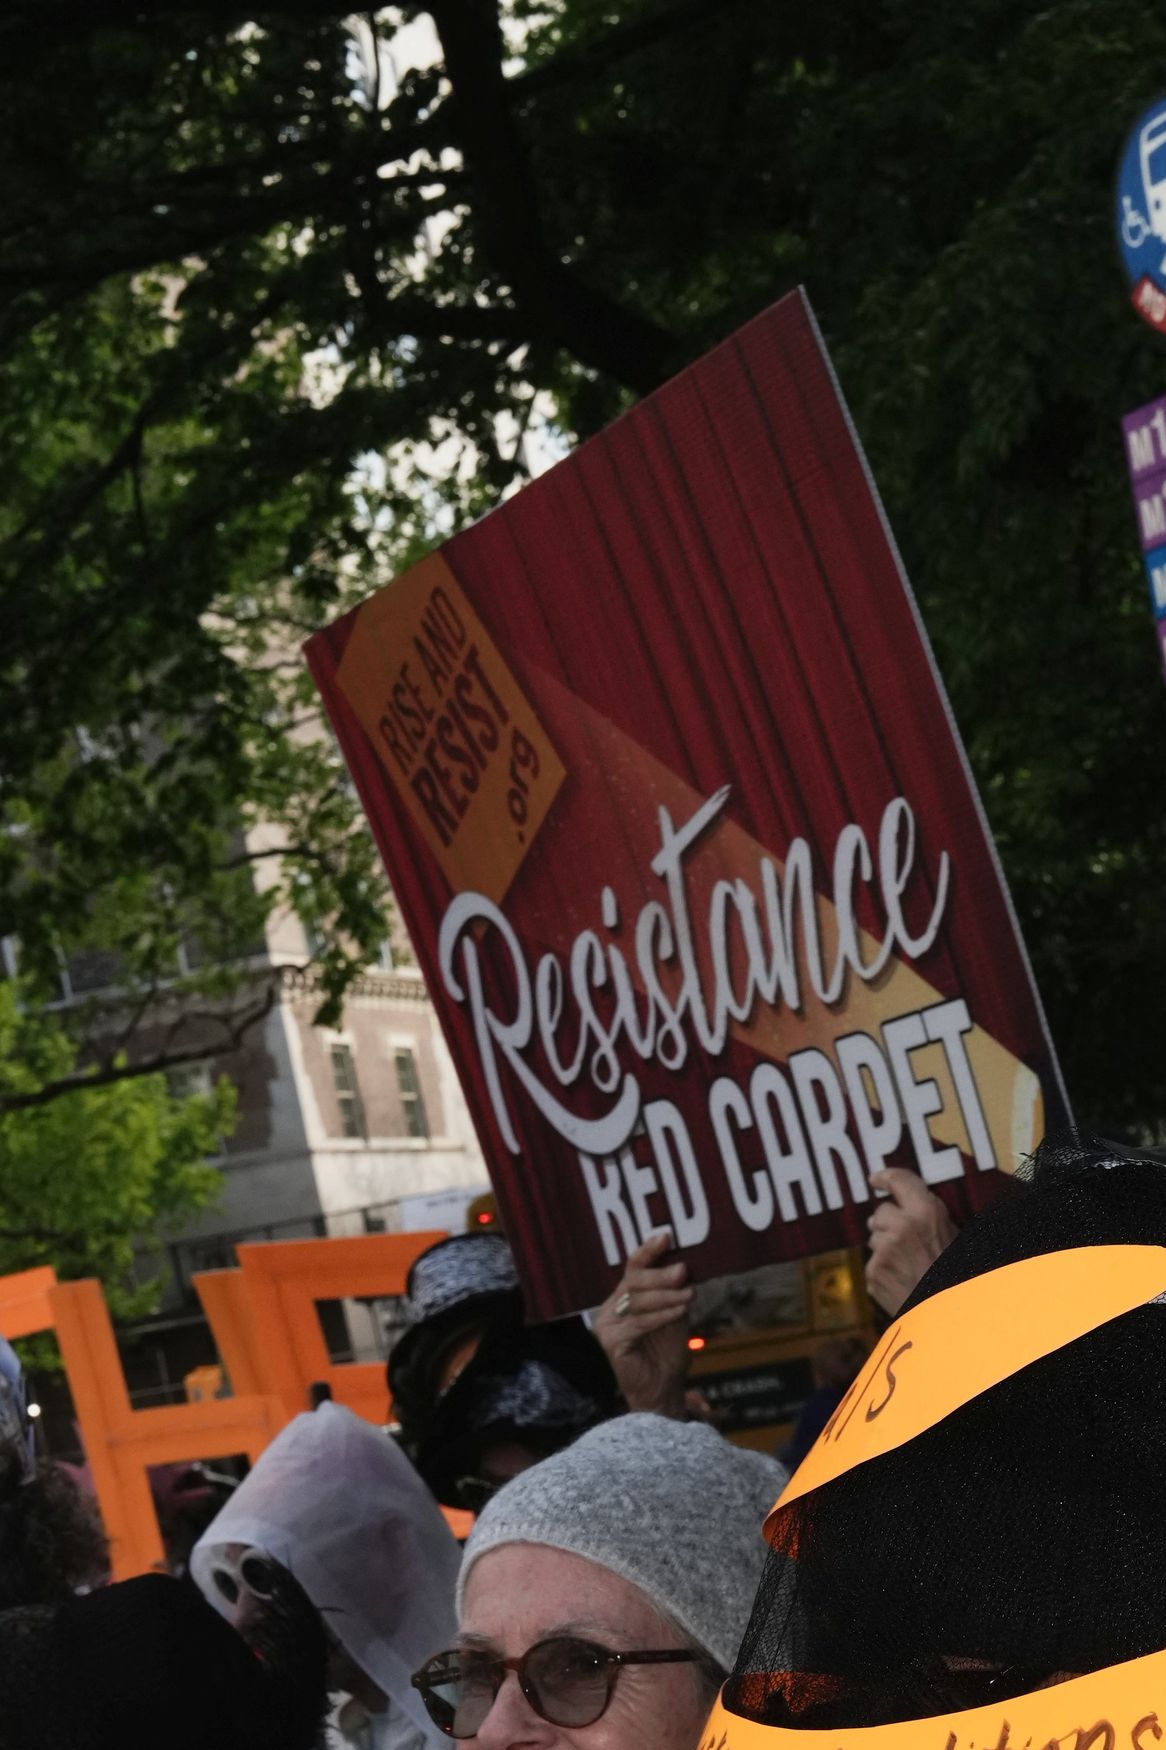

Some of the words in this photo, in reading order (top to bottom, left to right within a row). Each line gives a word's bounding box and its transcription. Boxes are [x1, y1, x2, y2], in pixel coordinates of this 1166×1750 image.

[378, 663, 434, 774] RISE
[414, 586, 466, 696] AND
[411, 643, 509, 848] RESIST
[507, 726, 540, 845] .org
[438, 784, 949, 1155] Resistance
[579, 1101, 710, 1266] RED
[708, 999, 996, 1232] CARPET
